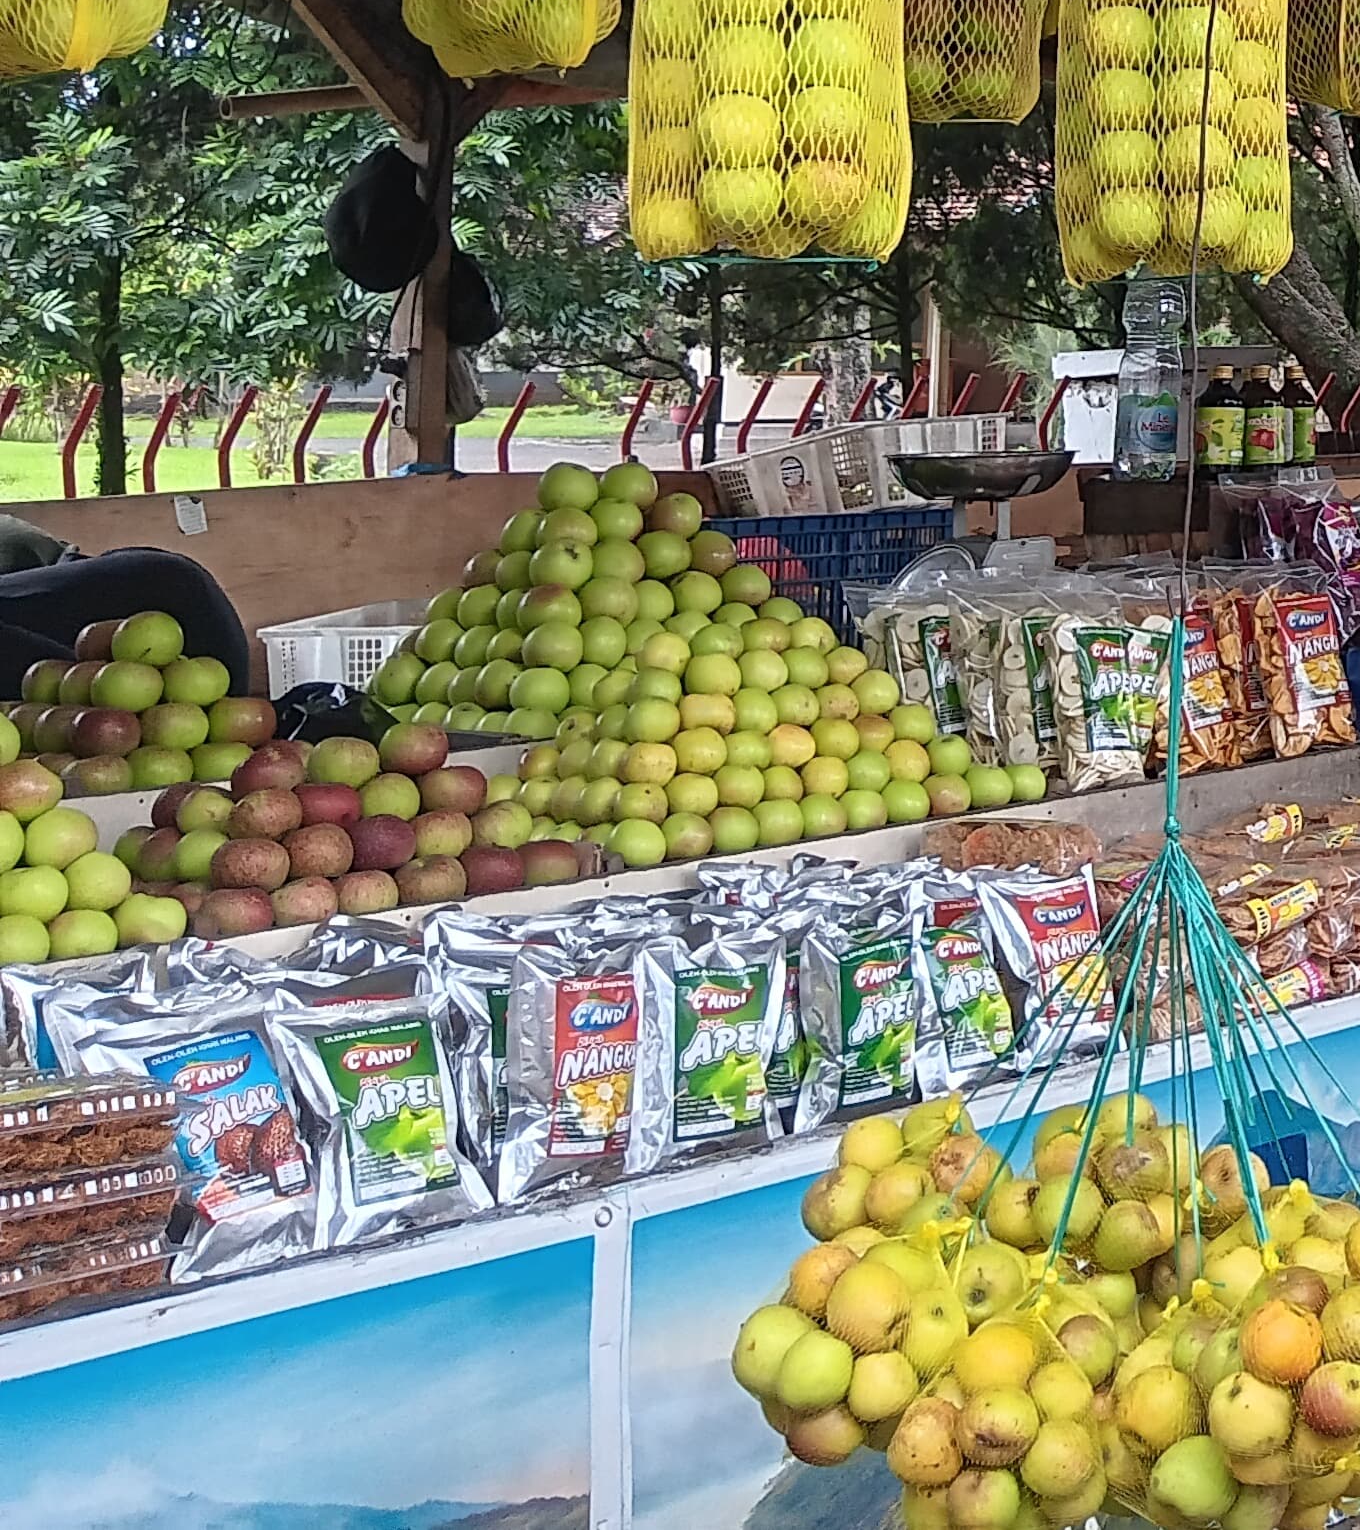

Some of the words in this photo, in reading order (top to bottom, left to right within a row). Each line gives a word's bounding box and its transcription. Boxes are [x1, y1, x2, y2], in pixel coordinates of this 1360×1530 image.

[1288, 613, 1325, 627] C'ANDI
[1184, 628, 1205, 644] ANDI
[1091, 644, 1125, 660] C'AND
[1040, 931, 1101, 970] NANG
[692, 990, 747, 1010] C'ANDI
[572, 1002, 630, 1027] C'ANDI
[346, 1045, 413, 1070] C'ANDI
[174, 1060, 247, 1090] C'ANDI
[352, 1075, 442, 1130] APEL
[186, 1083, 282, 1157] SALAK
